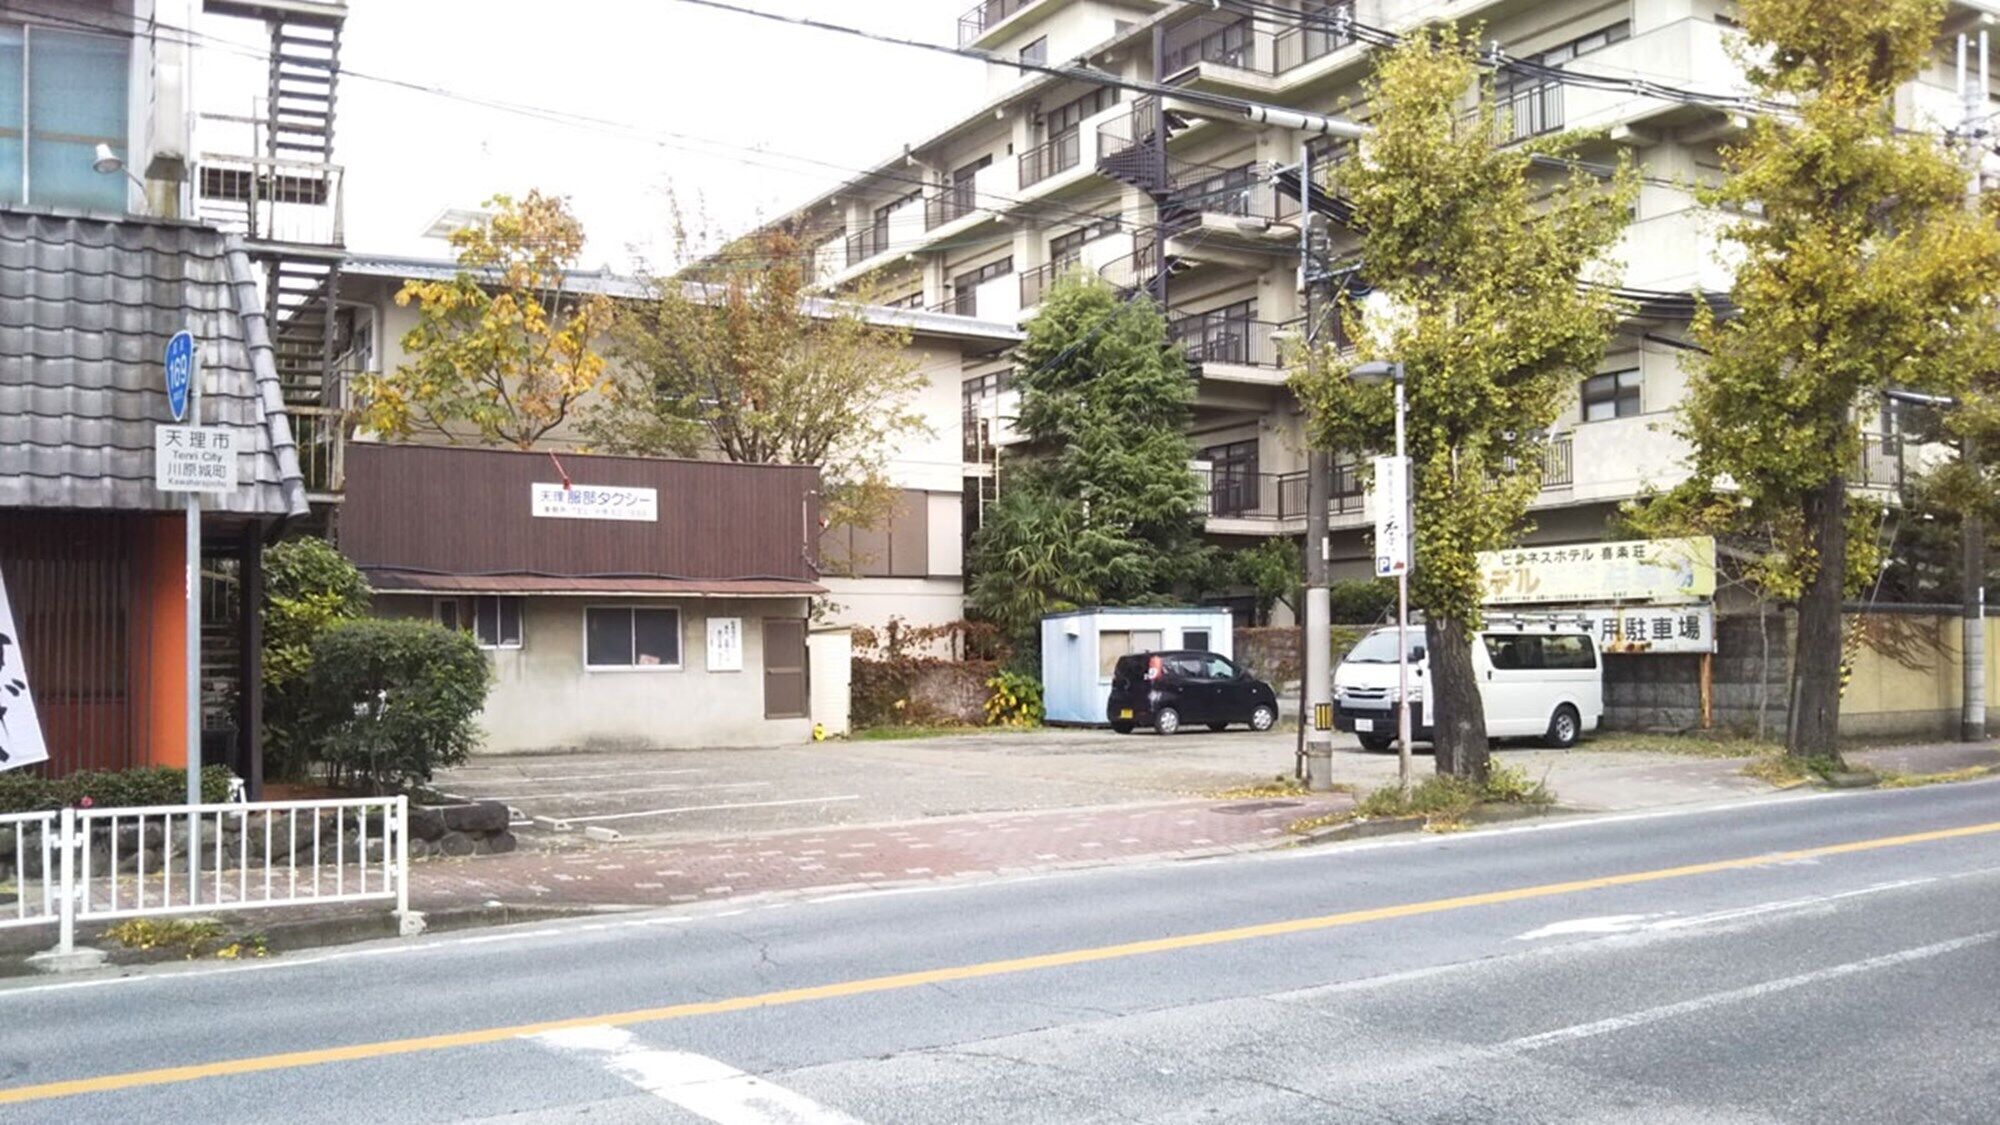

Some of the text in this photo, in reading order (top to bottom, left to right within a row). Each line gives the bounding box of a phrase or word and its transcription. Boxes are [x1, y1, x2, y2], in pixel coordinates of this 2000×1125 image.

[169, 353, 188, 390] 169
[164, 429, 231, 449] 天理市
[172, 450, 223, 463] Tenri City
[166, 462, 227, 479] 川原城町
[1586, 615, 1701, 643] 用駐車場
